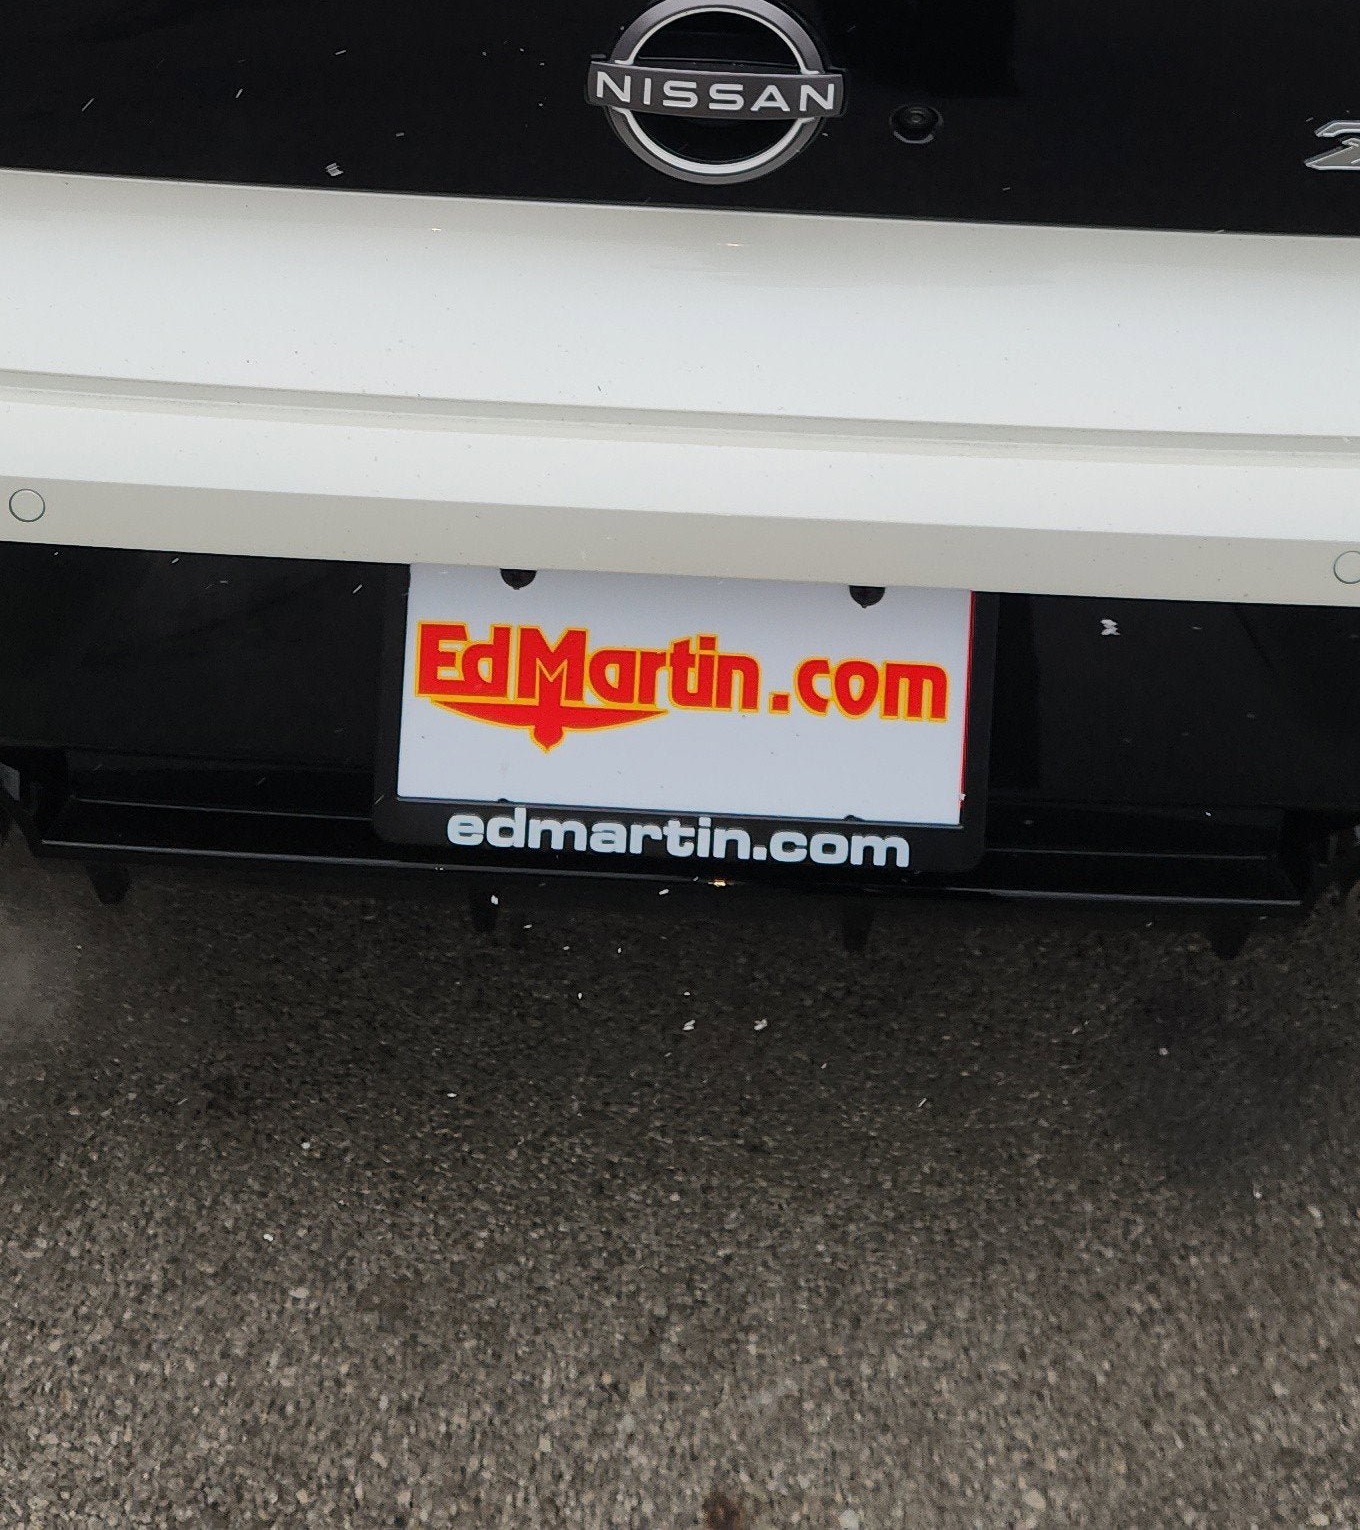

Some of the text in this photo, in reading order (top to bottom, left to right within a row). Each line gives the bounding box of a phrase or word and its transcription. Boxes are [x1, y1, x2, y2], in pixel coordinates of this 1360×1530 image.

[596, 71, 835, 112] NISSAN
[415, 620, 949, 724] EdMartin.com
[446, 807, 911, 868] edmartin.com
